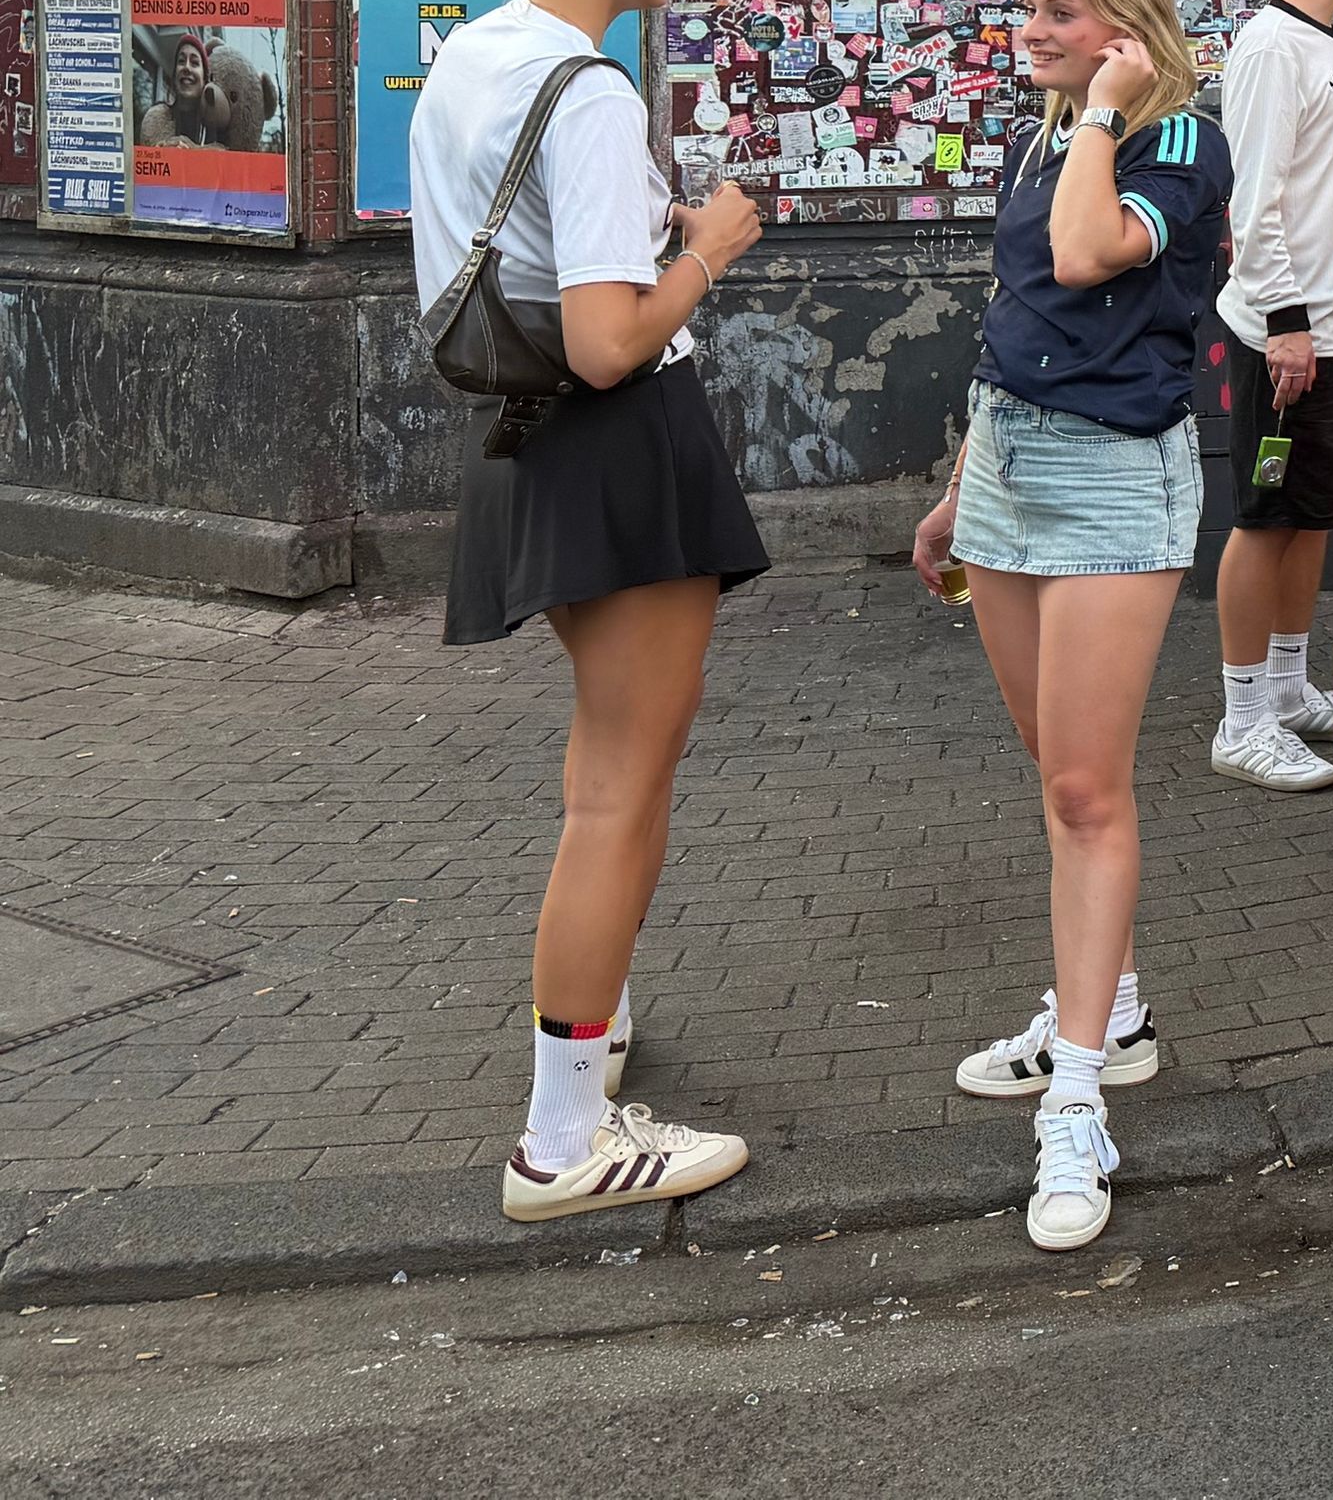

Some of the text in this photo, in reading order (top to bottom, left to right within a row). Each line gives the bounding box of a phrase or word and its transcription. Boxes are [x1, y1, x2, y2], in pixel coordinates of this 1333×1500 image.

[133, 0, 174, 16] DENNIS
[175, 0, 184, 15] &
[220, 0, 250, 16] BAND
[420, 5, 465, 18] 20.06.
[135, 160, 171, 178] SENTA
[727, 157, 804, 176] COPS ARE ENEMIES
[64, 178, 111, 201] BLUE SHELL
